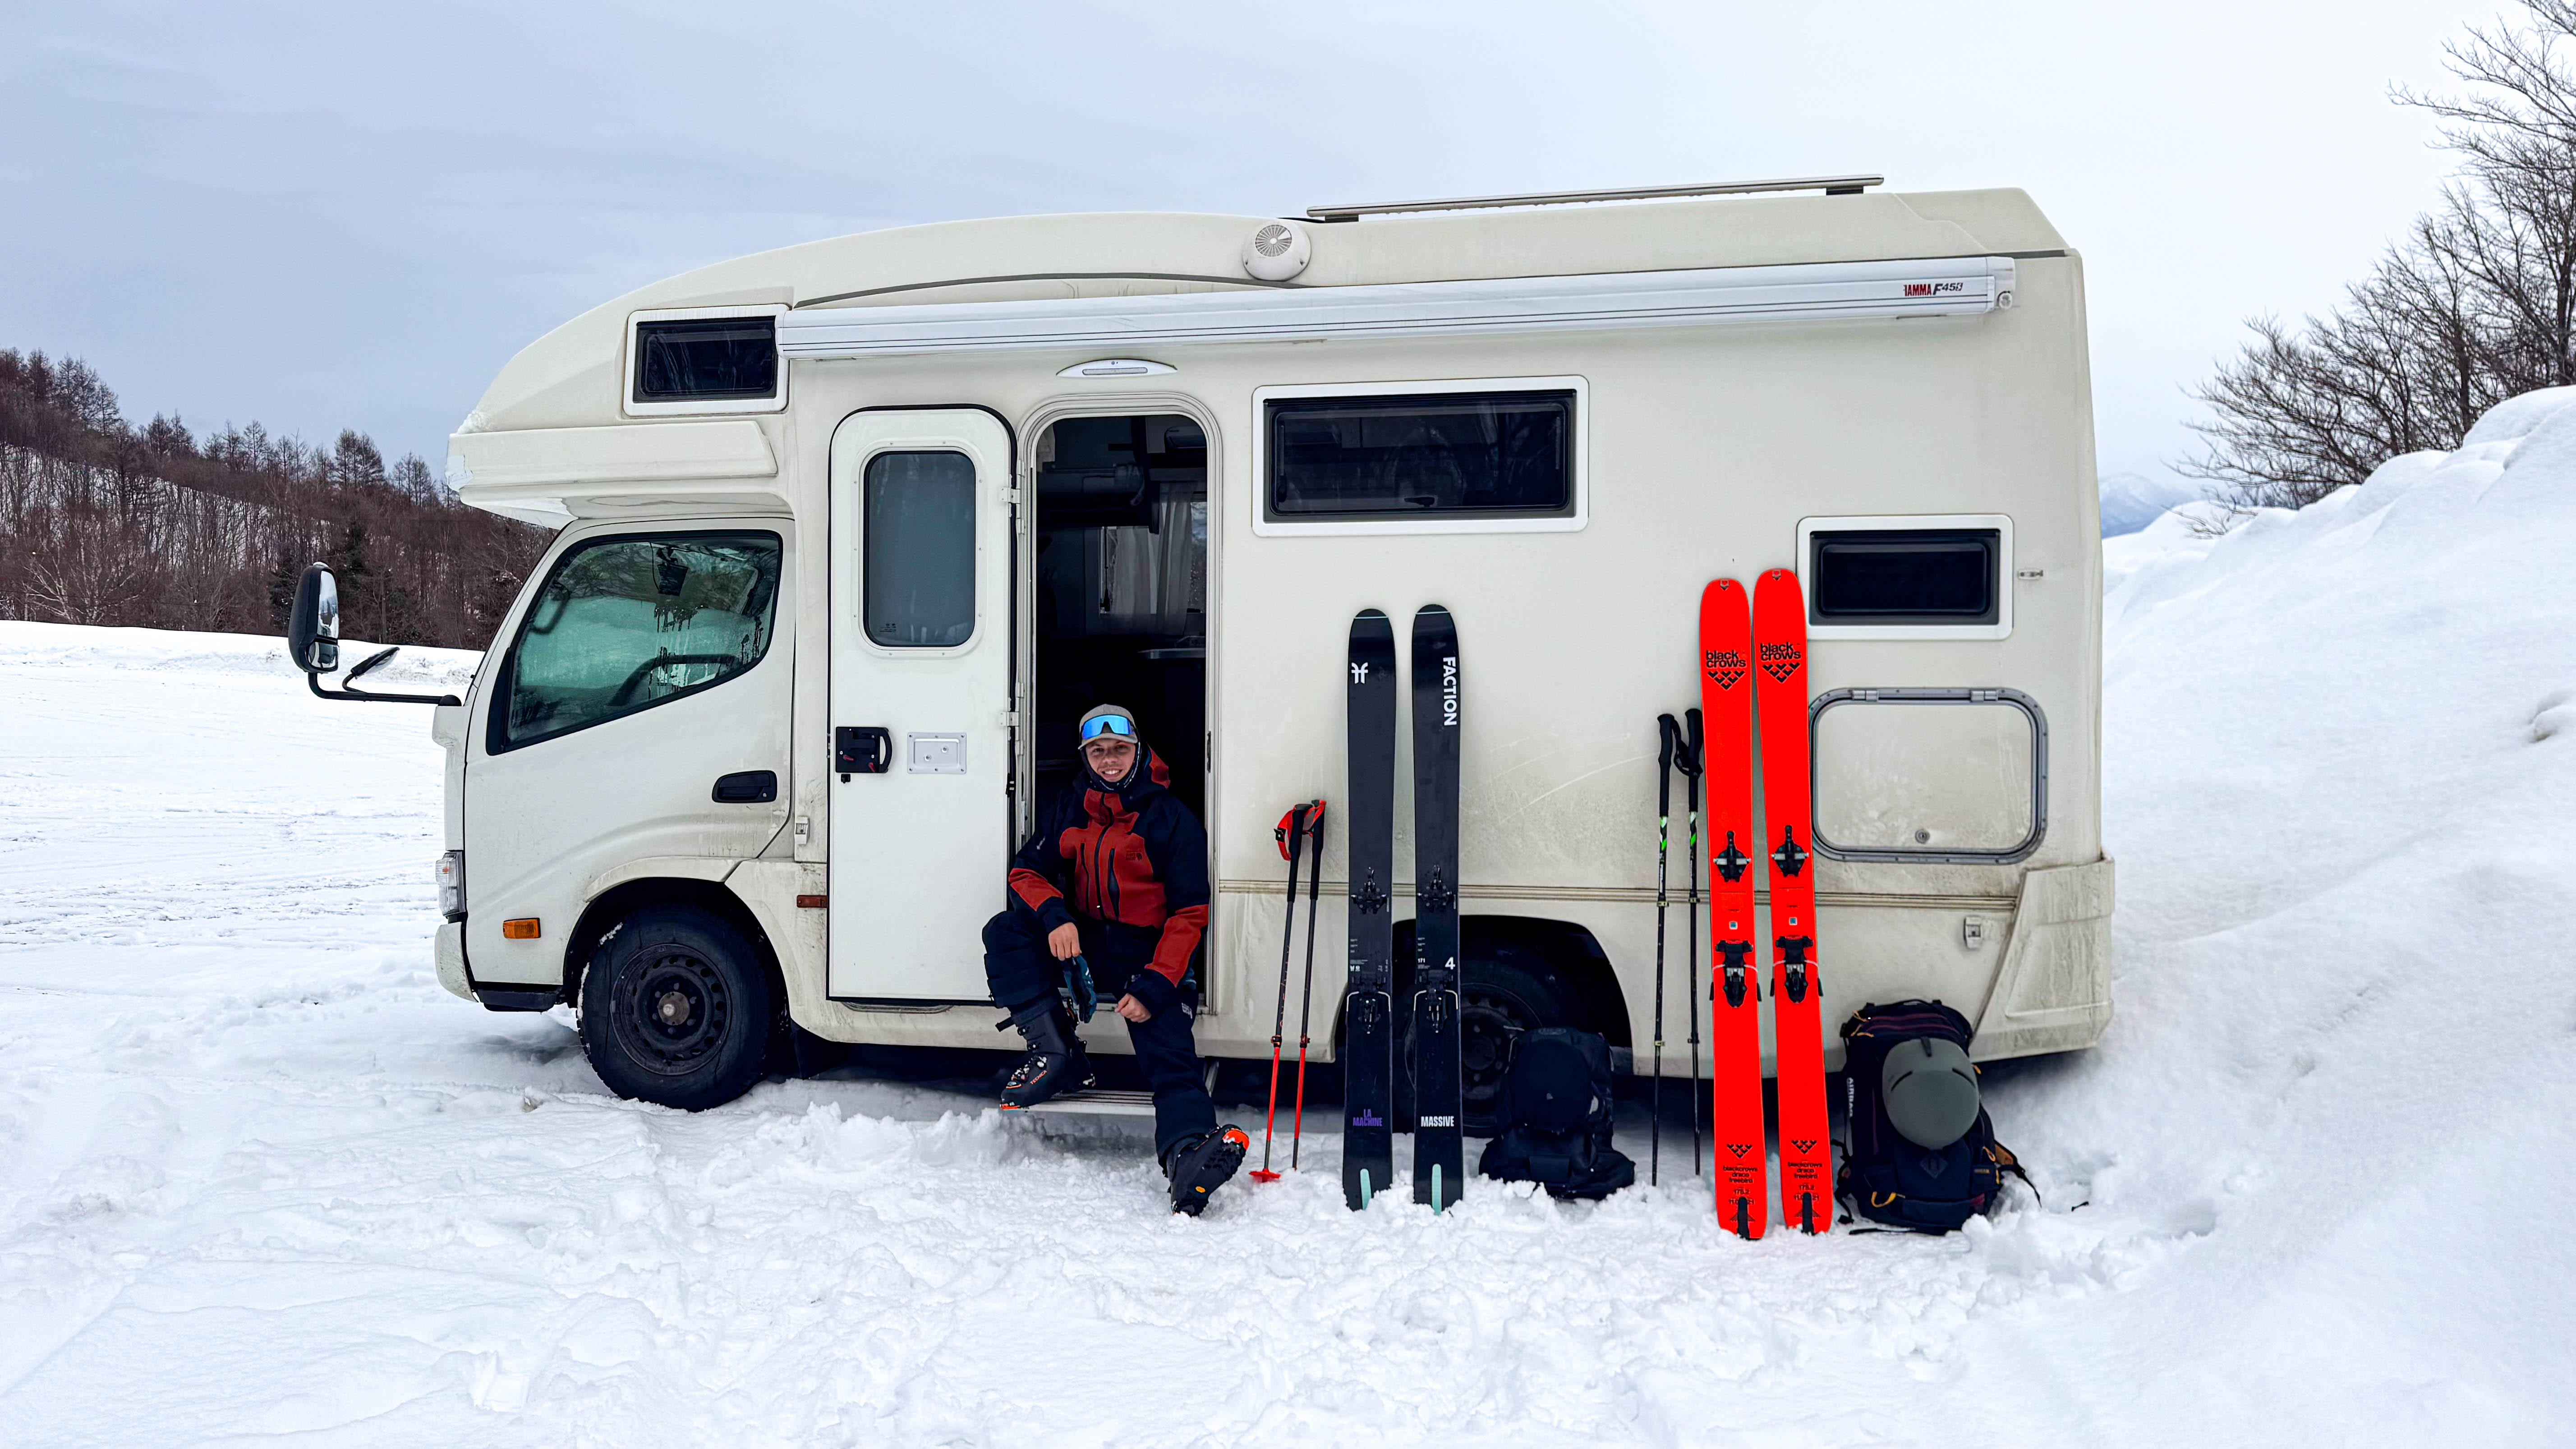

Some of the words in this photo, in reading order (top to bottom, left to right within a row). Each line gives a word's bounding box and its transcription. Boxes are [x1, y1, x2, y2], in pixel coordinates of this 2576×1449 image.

[1760, 642, 1794, 653] black
[1706, 649, 1739, 660] black
[1761, 651, 1801, 661] crows
[1706, 659, 1746, 668] crows
[1443, 656, 1457, 726] FACTION
[1444, 957, 1455, 970] 4
[1363, 1109, 1372, 1118] LA
[1352, 1117, 1382, 1127] MACHINE
[1421, 1116, 1454, 1127] MASSIVE
